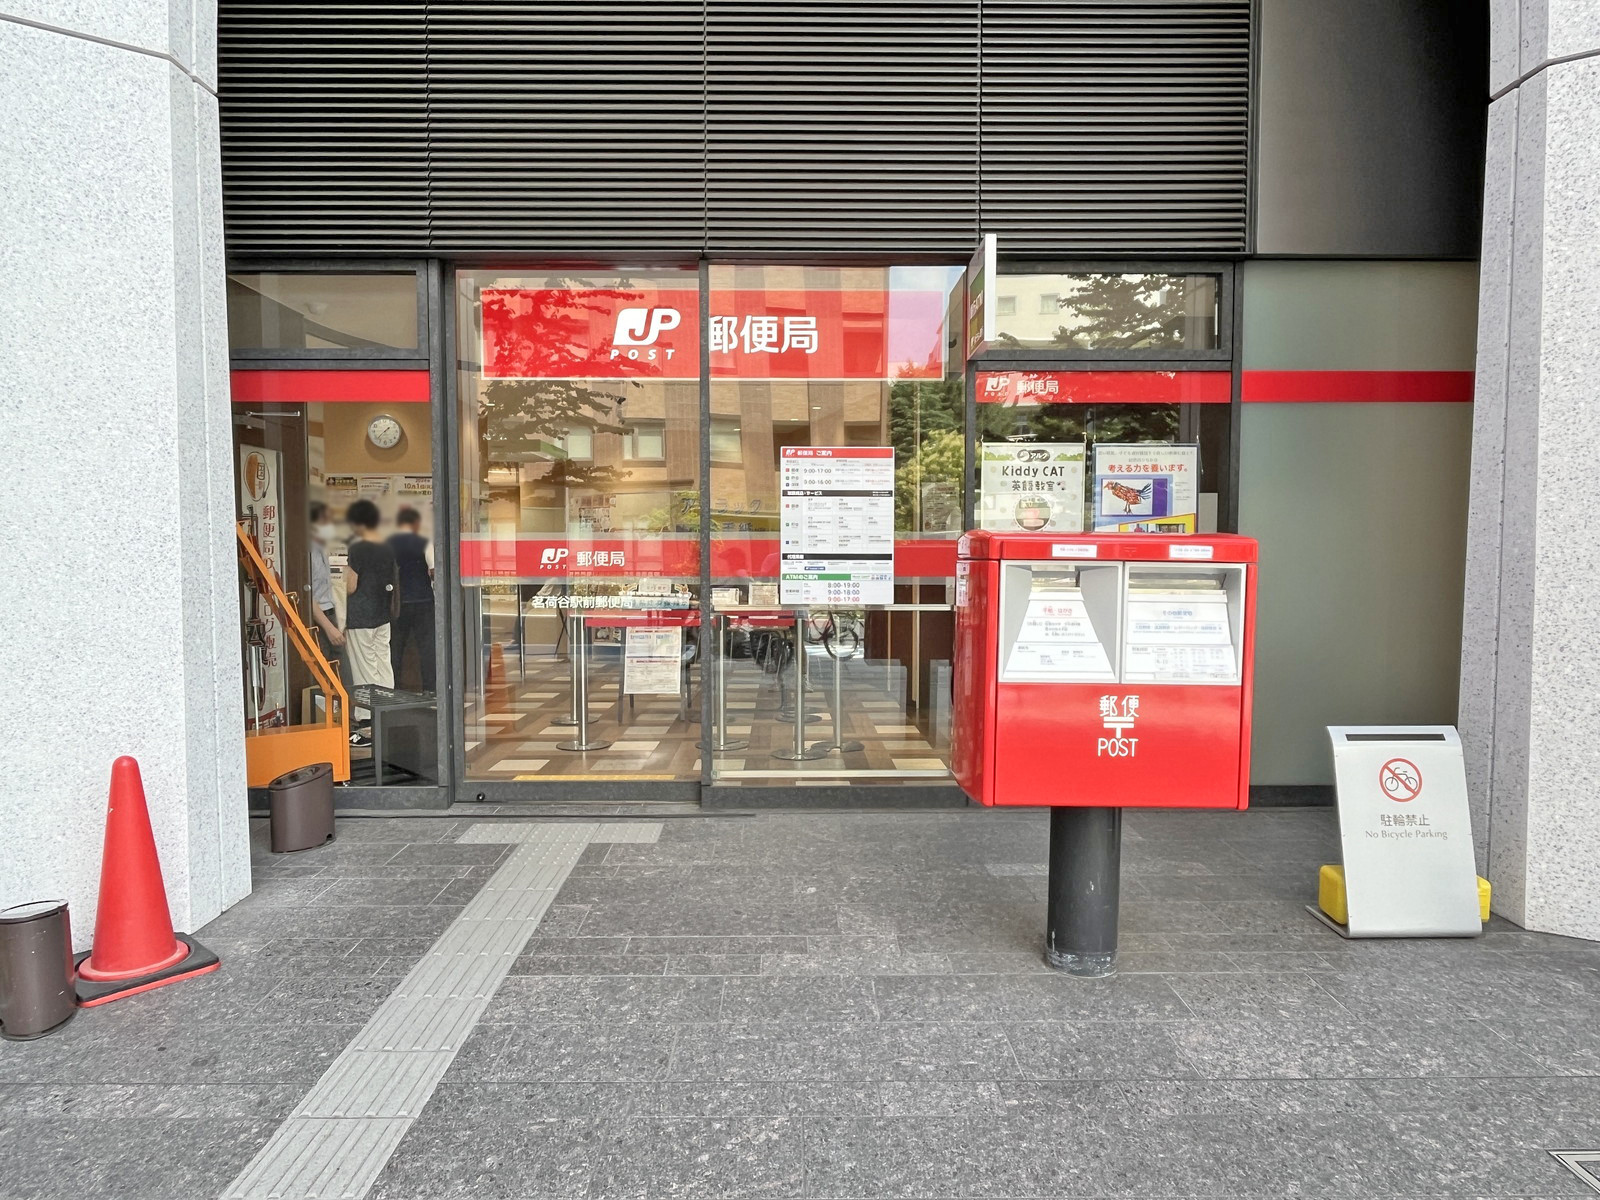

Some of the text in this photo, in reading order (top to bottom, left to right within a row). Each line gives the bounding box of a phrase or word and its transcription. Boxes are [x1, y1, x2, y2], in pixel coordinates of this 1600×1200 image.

[709, 315, 819, 354] 郵便局
[610, 348, 676, 361] POST
[1016, 379, 1059, 395] 郵便局
[1029, 452, 1049, 460] アルク
[1002, 465, 1065, 478] Kiddy CAT
[1012, 480, 1055, 491] 英語教室
[576, 551, 625, 567] 郵便局
[531, 596, 633, 609] 茗荷谷駅前郵便局
[1099, 695, 1140, 718] 郵便
[1097, 738, 1139, 757] POST
[1380, 814, 1430, 827] 駐輪禁止
[1365, 829, 1448, 840] No Bicycle Parking
